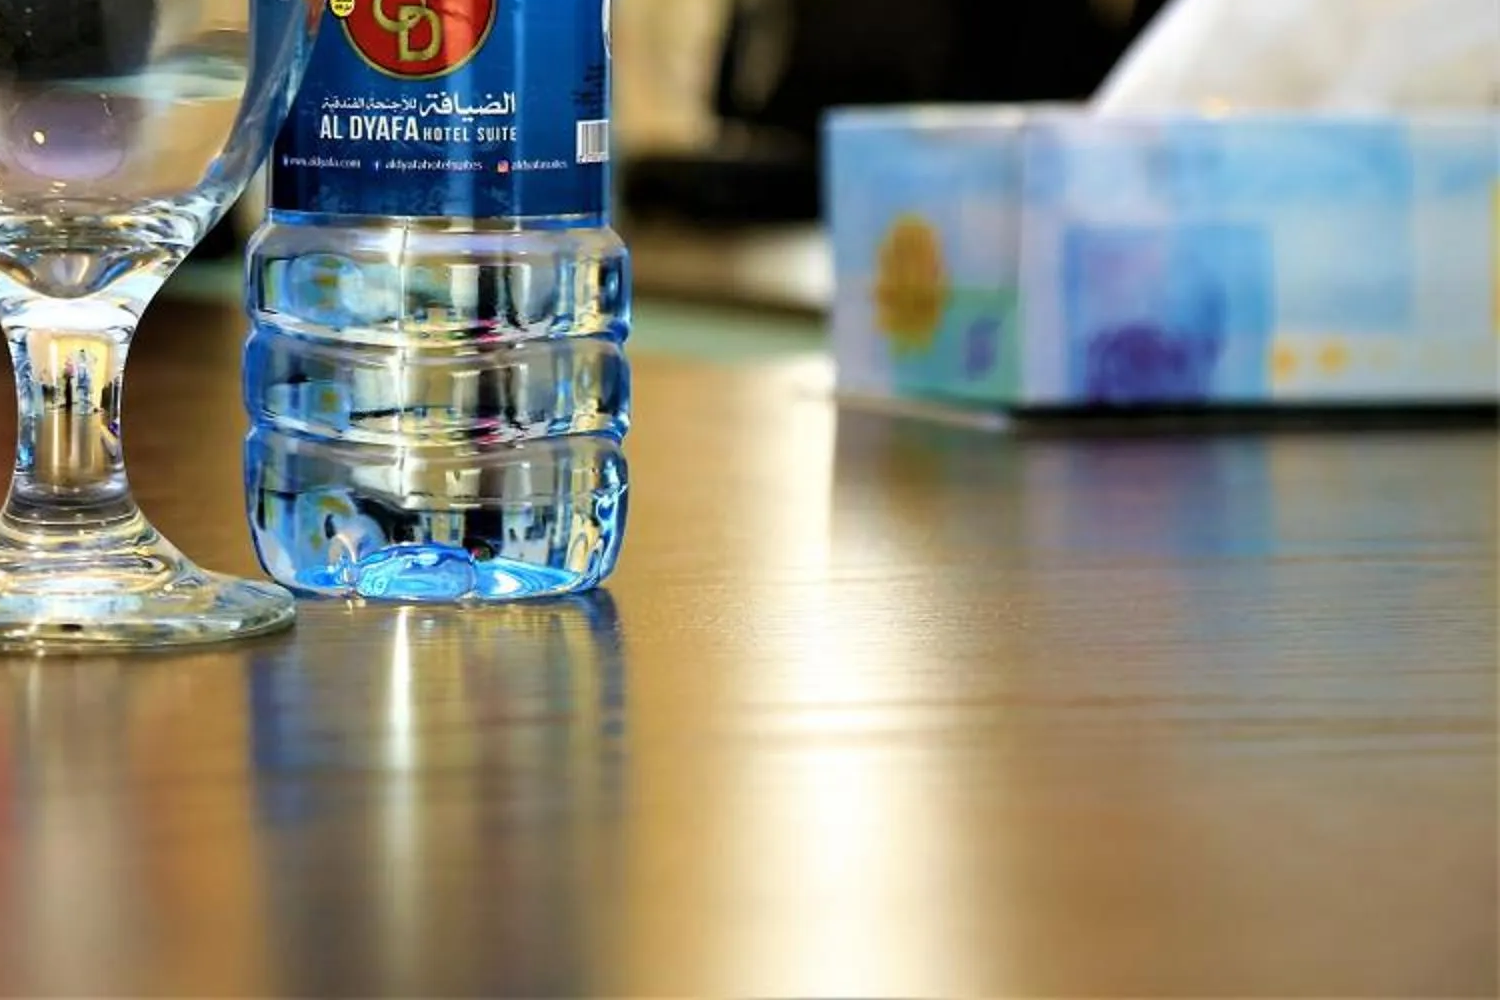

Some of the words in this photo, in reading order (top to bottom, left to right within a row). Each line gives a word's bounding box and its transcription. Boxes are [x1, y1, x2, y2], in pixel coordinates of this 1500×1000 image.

[419, 92, 516, 123] الضيافة
[320, 115, 344, 140] AL
[350, 115, 420, 141] DYAFA
[423, 127, 470, 142] HOTEL
[477, 127, 517, 141] SUITE
